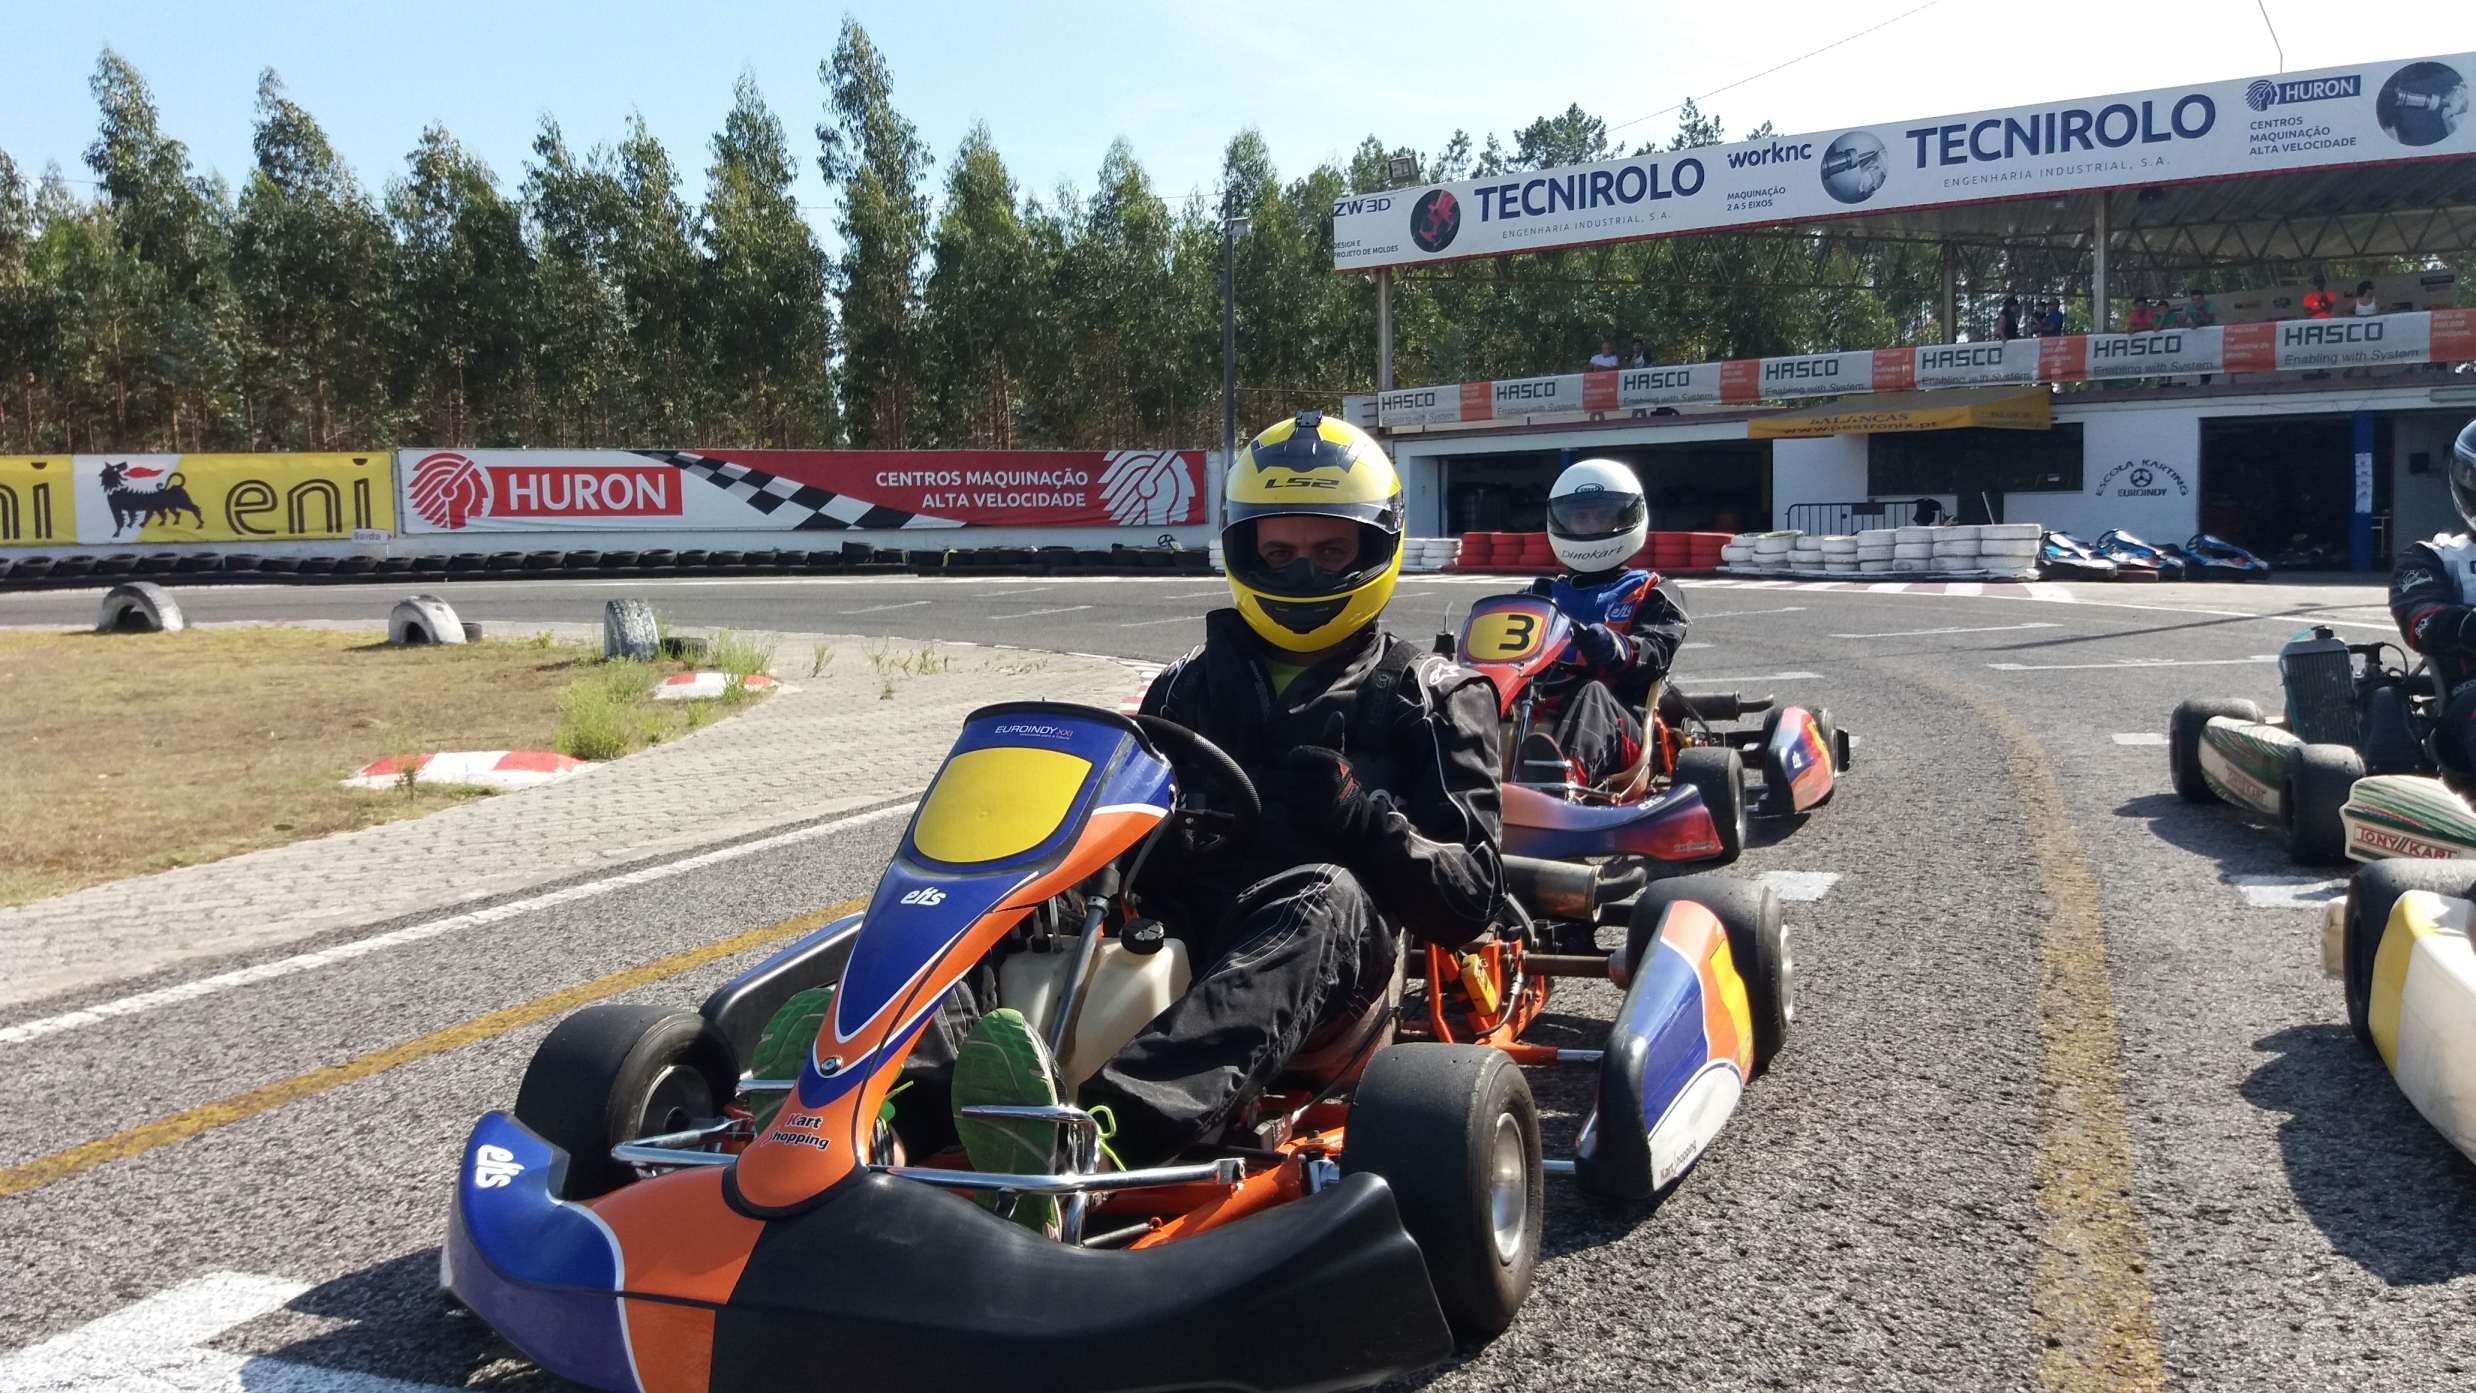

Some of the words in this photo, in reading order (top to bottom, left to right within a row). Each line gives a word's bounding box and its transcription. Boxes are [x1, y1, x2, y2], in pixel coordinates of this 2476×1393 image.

[2286, 78, 2354, 101] HURON
[1905, 93, 2217, 169] TECNIROLO
[2250, 116, 2303, 130] CENTROS
[2249, 126, 2331, 142] MAQUINAÇÃO
[2249, 145, 2279, 155] ALTA
[2282, 137, 2357, 152] VELOCIDADE
[1943, 170, 2032, 188] ENGENHARIA
[2140, 156, 2171, 168] S.A.
[1474, 157, 1705, 222] TECNIROLO
[1727, 186, 1786, 200] MAQUINAÇÃO
[1333, 198, 1391, 217] ZW3D
[1727, 203, 1732, 211] 2
[1748, 199, 1773, 209] EIXOS
[1502, 223, 1570, 239] ENGENHARIA
[1649, 210, 1671, 222] S.A.
[1363, 247, 1371, 255] DE
[1373, 244, 1399, 254] MOLDES
[2284, 322, 2384, 347] HASCO
[2094, 335, 2182, 358] HASCO
[1922, 347, 2003, 369] HASCO
[2171, 361, 2213, 372] System
[2284, 352, 2338, 366] Enabling
[2343, 351, 2366, 363] with
[2372, 349, 2419, 362] System
[1765, 359, 1839, 380] HASCO
[1624, 371, 1690, 391] HASCO
[1496, 382, 1556, 400] HASCO
[1381, 392, 1435, 411] HASCO
[876, 471, 961, 487] CENTROS
[966, 468, 1088, 489] MAQUINAÇÃO
[1265, 477, 1340, 489] LS2
[2096, 461, 2134, 496] ESCOLA
[2142, 459, 2188, 496] KARTING
[225, 458, 371, 535] eni
[508, 473, 667, 511] HURON
[922, 494, 968, 509] ALTA
[973, 493, 1086, 508] VELOCIDADE
[2118, 488, 2167, 497] EUROINDY
[1499, 614, 1534, 650] 3
[784, 1112, 823, 1130] Kart
